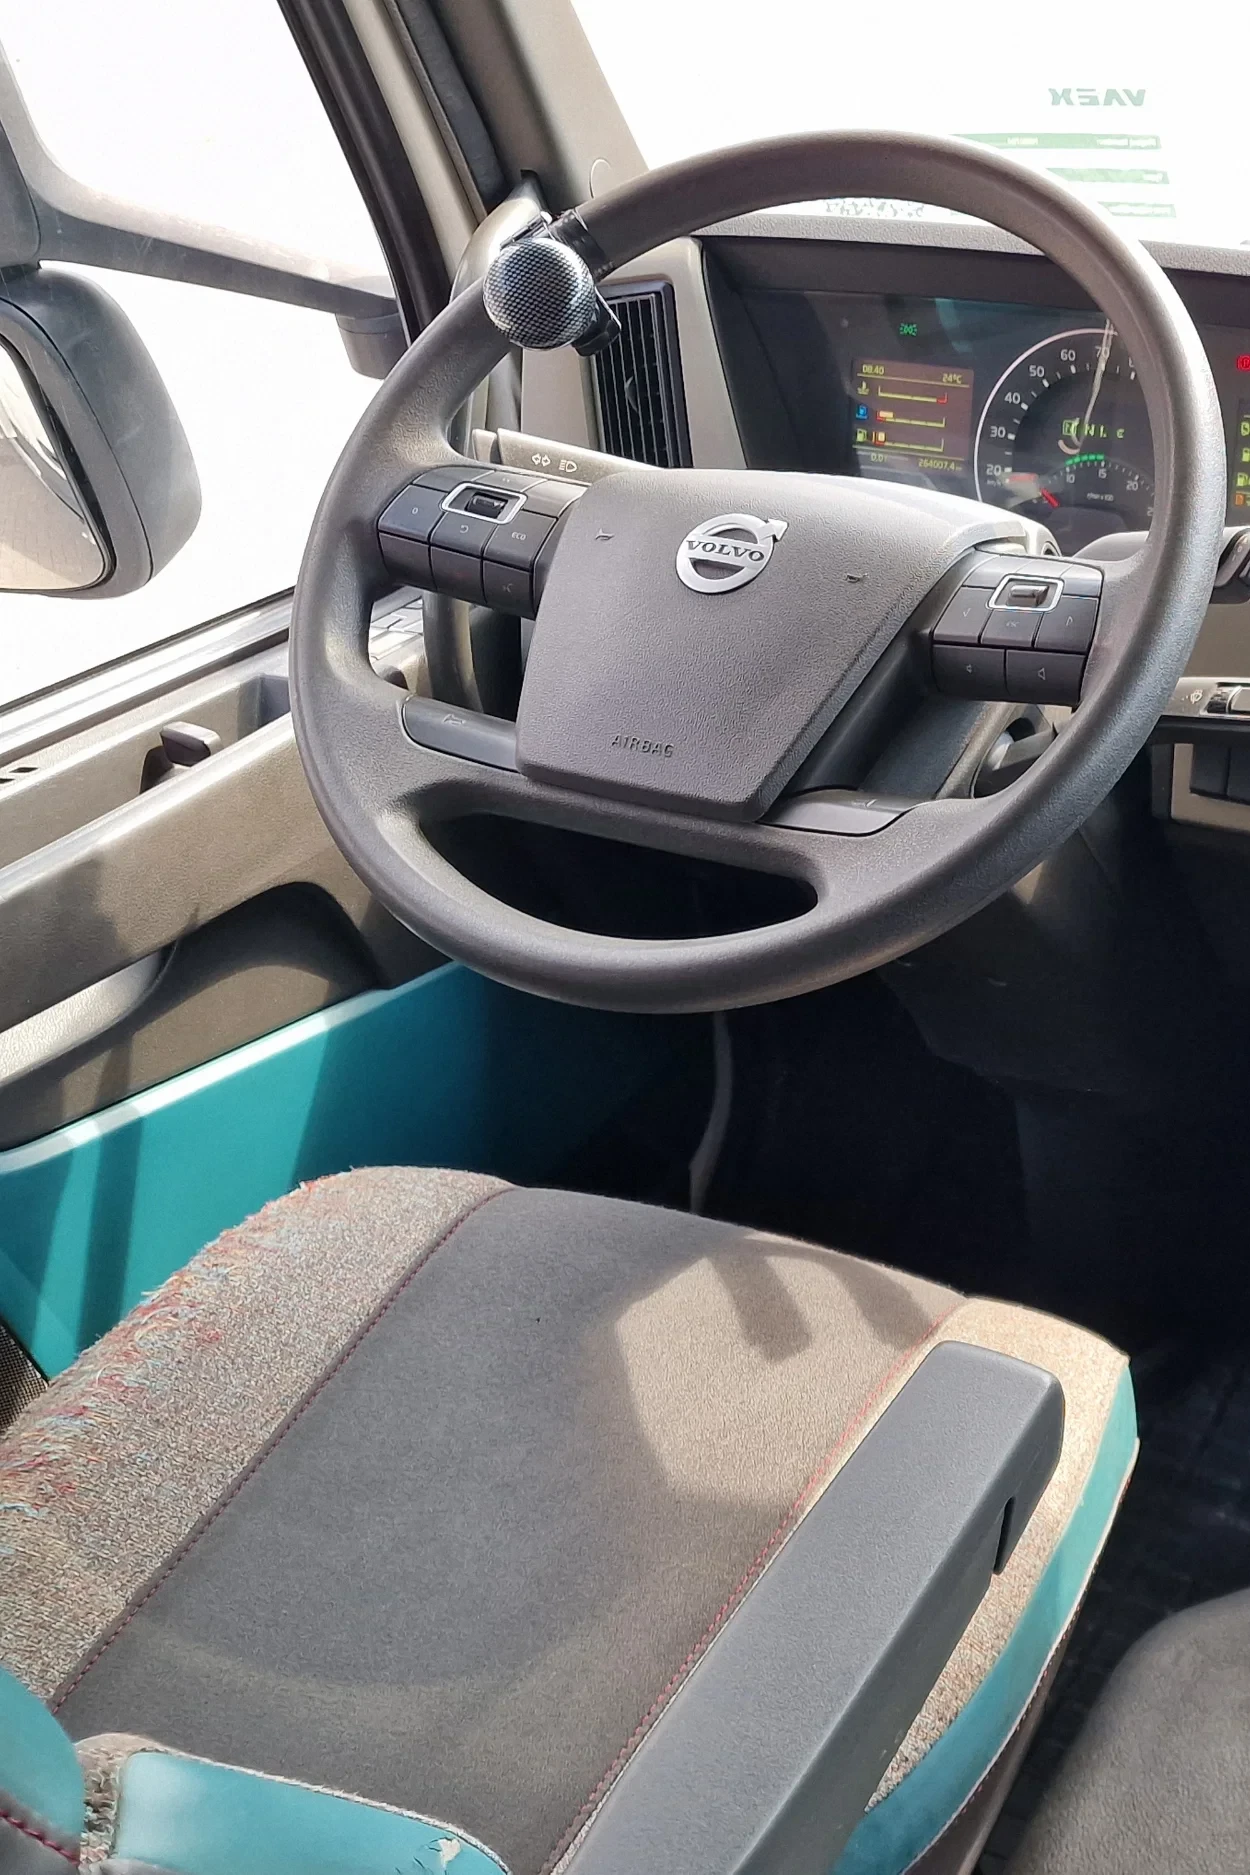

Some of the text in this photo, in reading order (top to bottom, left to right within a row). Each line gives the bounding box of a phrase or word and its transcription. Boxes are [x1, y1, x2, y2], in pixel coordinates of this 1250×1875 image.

[1060, 349, 1076, 361] 60
[1029, 365, 1045, 378] 50
[1004, 391, 1021, 405] 40
[989, 426, 1006, 438] 30
[986, 463, 1001, 476] 20
[1099, 469, 1107, 479] 15
[1066, 474, 1075, 483] 10
[1126, 481, 1138, 491] 20
[511, 531, 526, 541] ECO
[686, 540, 764, 562] VOLVO
[611, 734, 675, 758] AIRBAG
